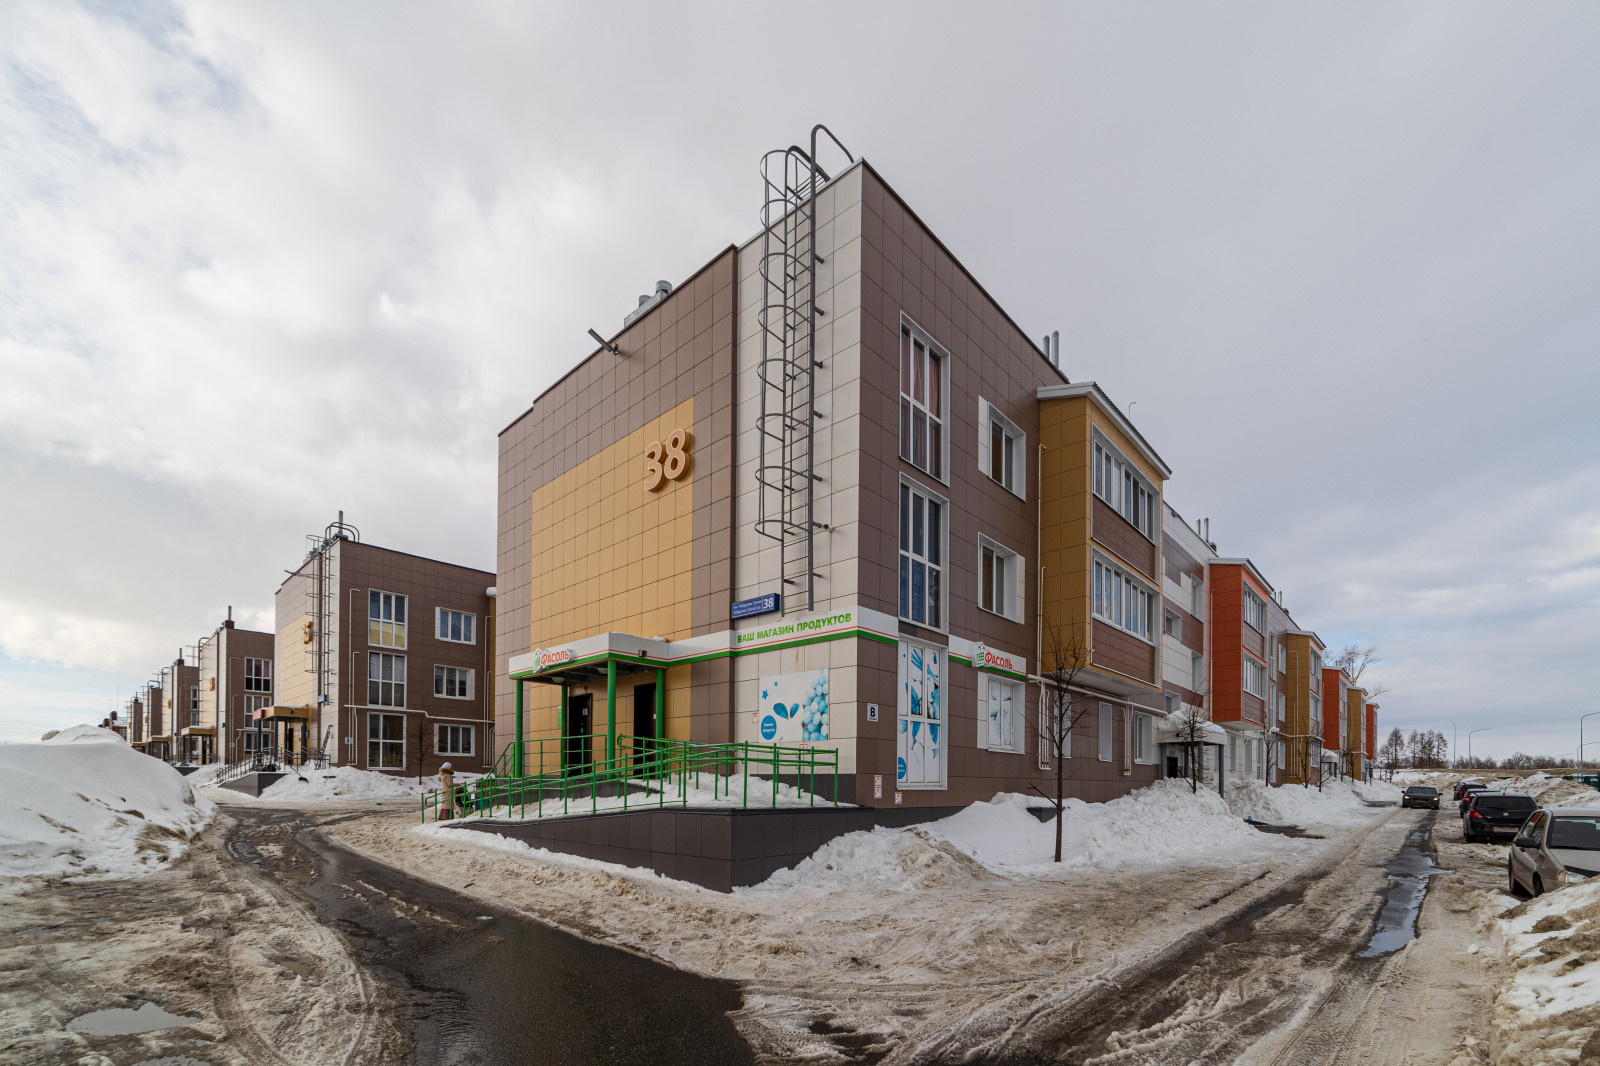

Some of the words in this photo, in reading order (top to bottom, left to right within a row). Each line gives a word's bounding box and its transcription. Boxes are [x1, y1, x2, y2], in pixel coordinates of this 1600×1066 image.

[643, 429, 688, 491] 38
[763, 597, 774, 609] 38
[737, 632, 755, 643] ВАШ
[756, 624, 794, 640] МАГАЗИН
[796, 613, 852, 632] ПРОДУКТОВ
[541, 650, 570, 666] ФАСОЛЬ
[984, 651, 1013, 670] ФАСОЛЬ
